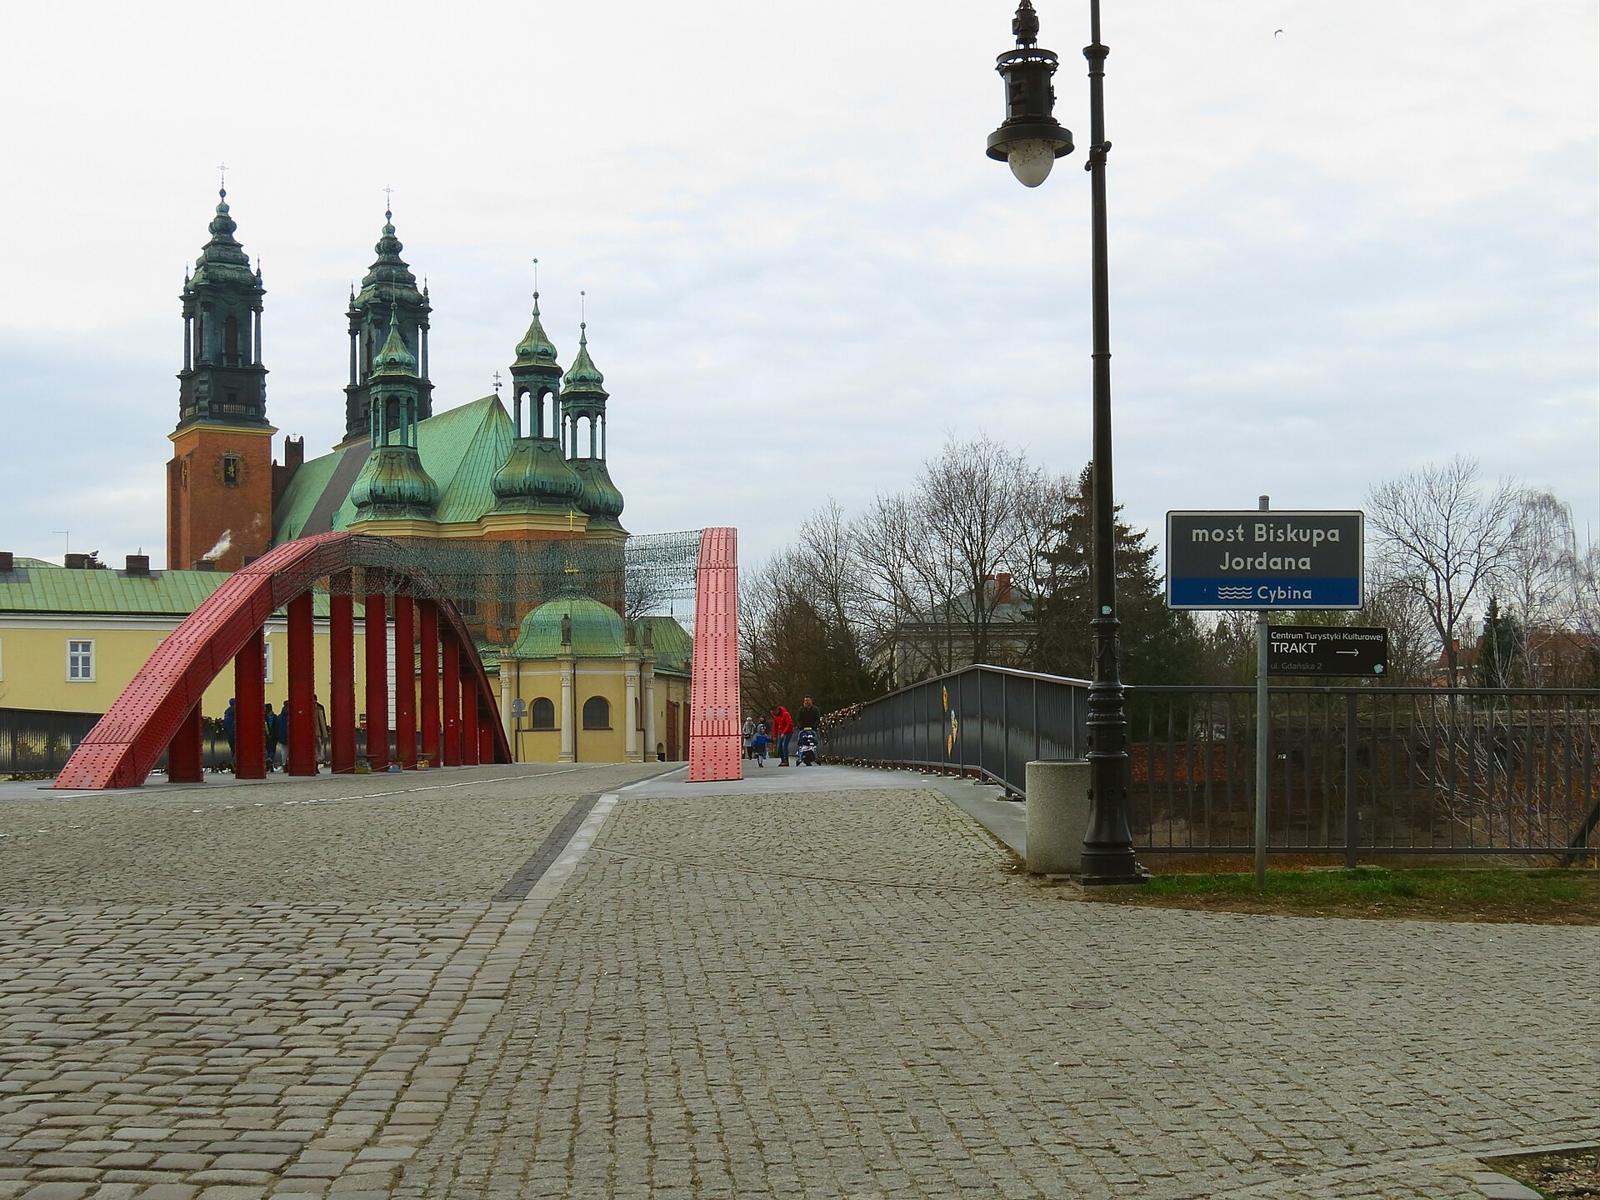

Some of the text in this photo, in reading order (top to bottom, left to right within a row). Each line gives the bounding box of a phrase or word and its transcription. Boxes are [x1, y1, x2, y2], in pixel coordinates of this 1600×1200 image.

[1192, 523, 1340, 547] most Biskupa
[1220, 551, 1311, 570] Jordana
[1257, 586, 1312, 603] Cybina
[1271, 631, 1384, 642] Centrum Turystyki Kulturowej
[1271, 642, 1317, 654] TRAKT
[1316, 662, 1323, 670] 2
